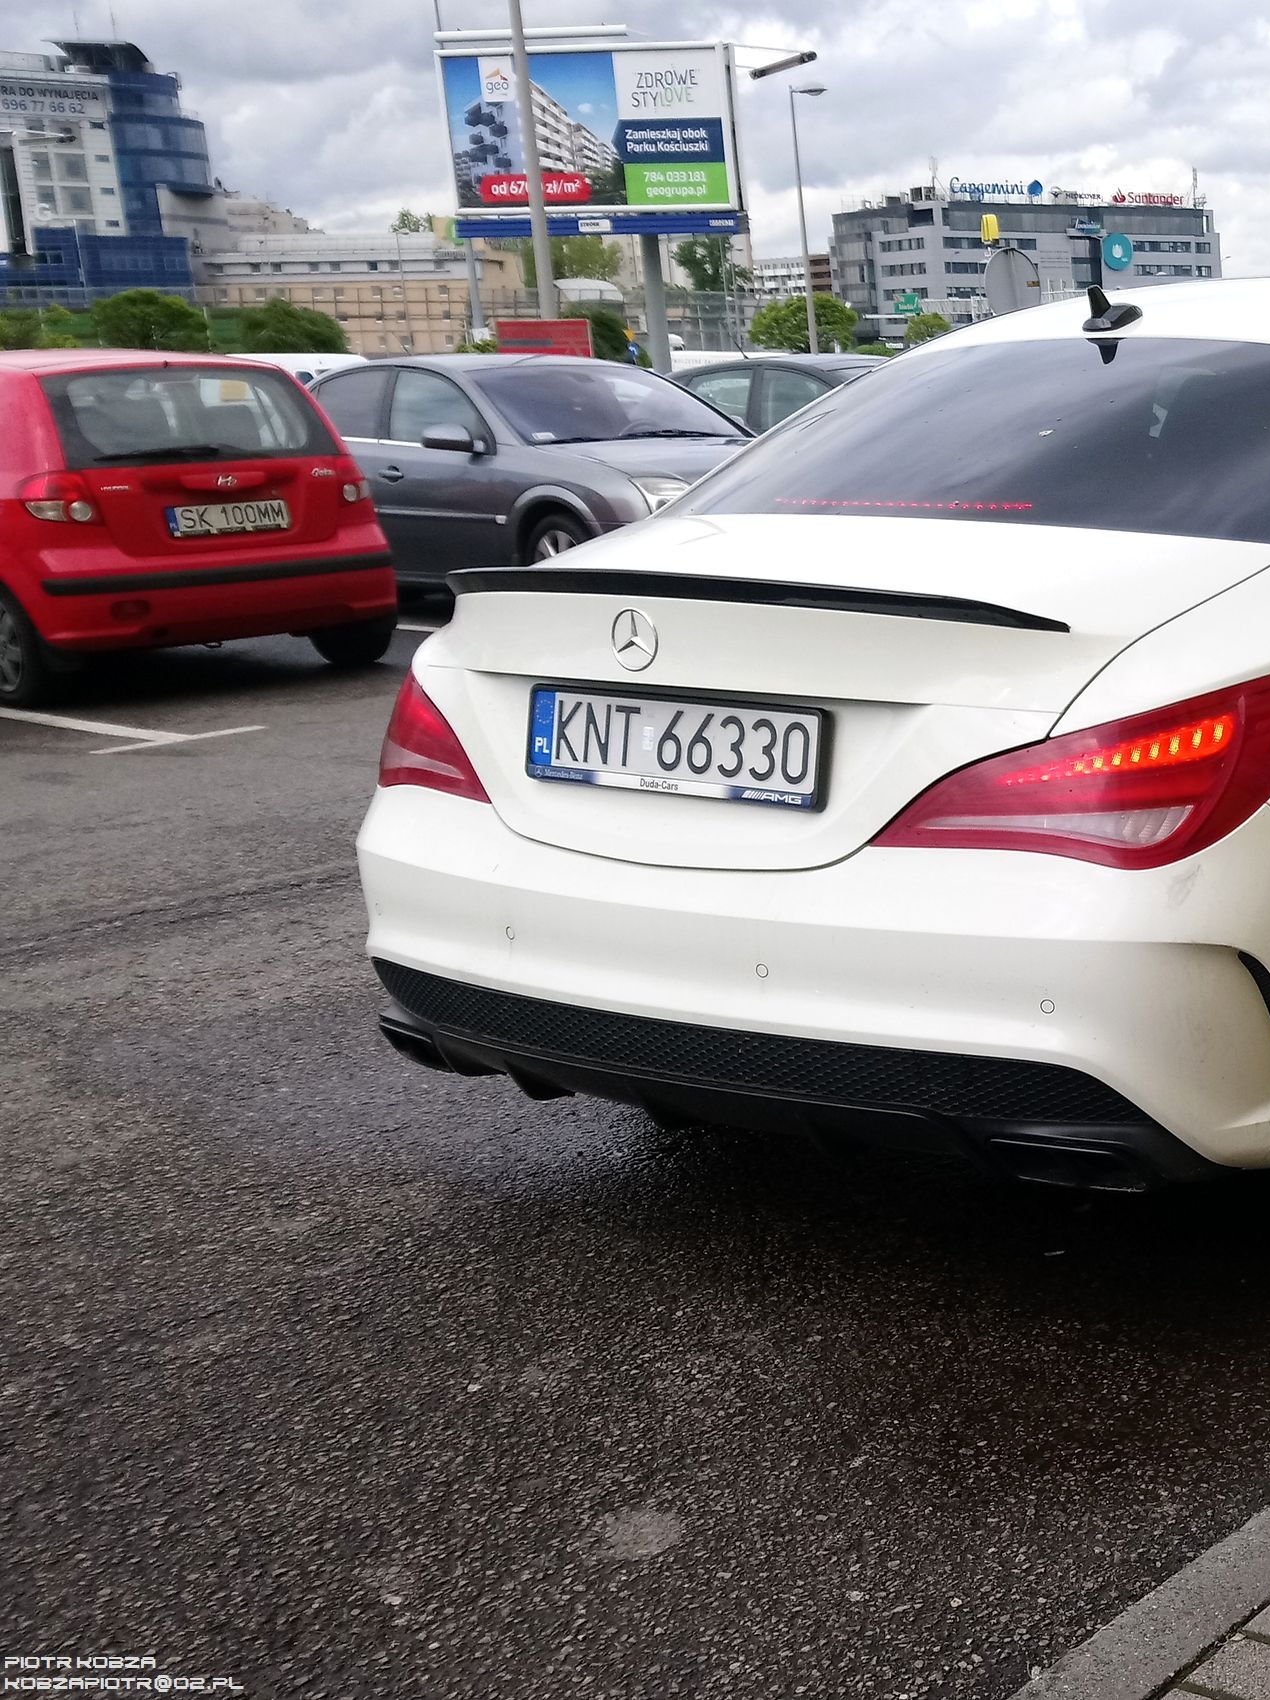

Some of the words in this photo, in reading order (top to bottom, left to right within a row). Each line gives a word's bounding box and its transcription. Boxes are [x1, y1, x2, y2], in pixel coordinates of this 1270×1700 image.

[486, 81, 509, 93] geo
[19, 87, 34, 97] DO
[36, 88, 99, 101] WYNAJĘCIA
[2, 98, 27, 111] 696
[31, 100, 44, 112] 77
[49, 101, 65, 112] 66
[69, 103, 85, 114] 62
[625, 129, 680, 140] Zamieszkaj
[682, 128, 707, 138] obok
[626, 142, 655, 152] Parku
[657, 140, 708, 152] Kościuszki
[643, 172, 663, 182] 784
[666, 171, 686, 182] 033
[688, 171, 706, 182] 181
[491, 182, 507, 195] od
[646, 185, 706, 197] geogrupa.pl
[950, 177, 1024, 199] Capgemini
[1128, 192, 1184, 205] Santander
[181, 507, 213, 528] SK
[221, 502, 285, 525] 100MM
[534, 736, 550, 754] PL
[554, 700, 642, 767] KNT
[656, 710, 811, 786] 66330
[639, 778, 679, 791] Duda-Cars
[760, 794, 802, 805] AMG
